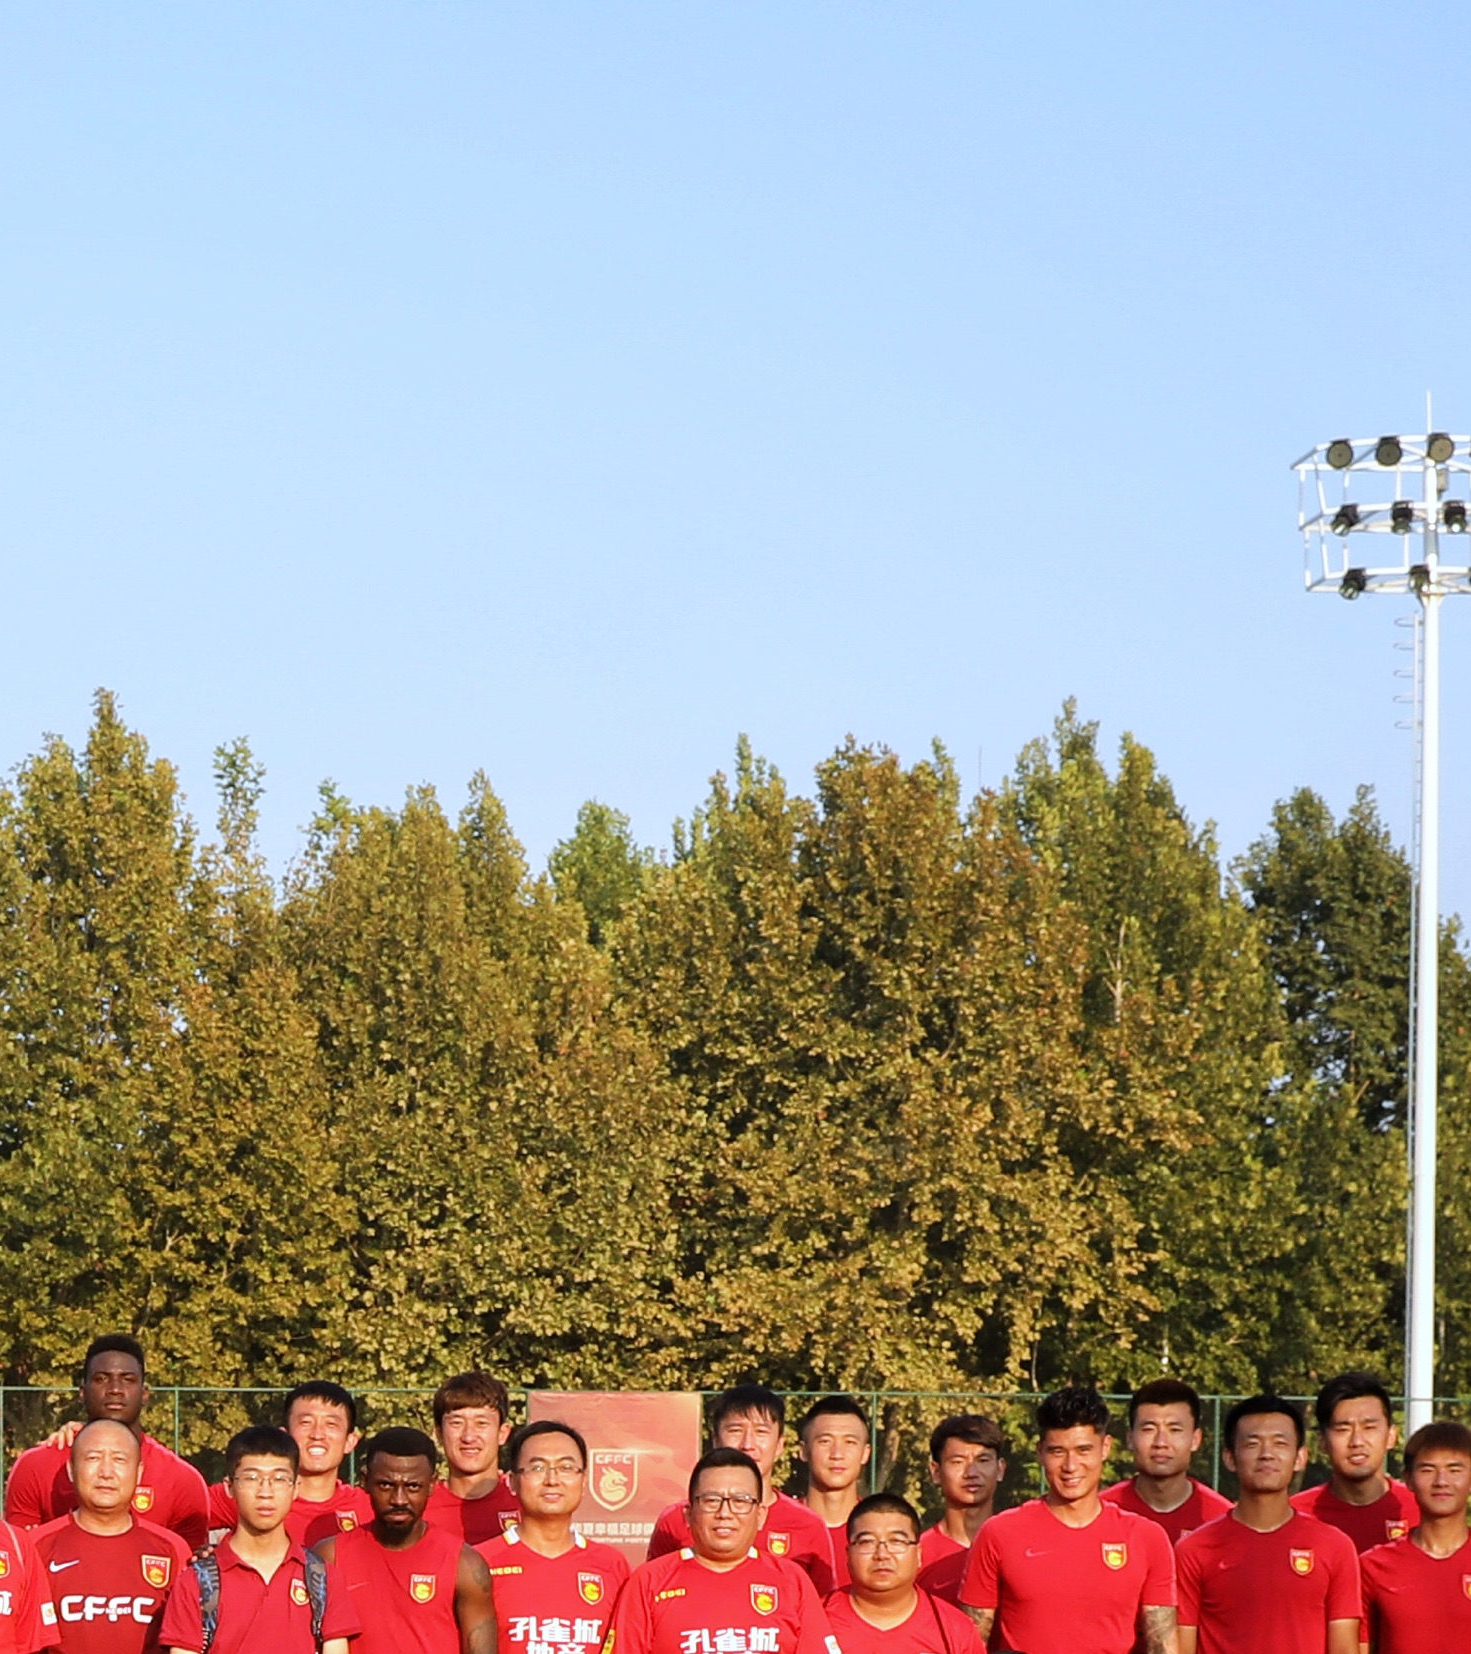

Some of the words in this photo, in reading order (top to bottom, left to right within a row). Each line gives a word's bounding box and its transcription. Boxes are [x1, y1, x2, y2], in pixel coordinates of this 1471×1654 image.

[595, 1454, 632, 1464] CFFC
[61, 1595, 155, 1624] CFFC
[508, 1616, 603, 1644] 孔雀城
[680, 1627, 780, 1654] 孔雀城
